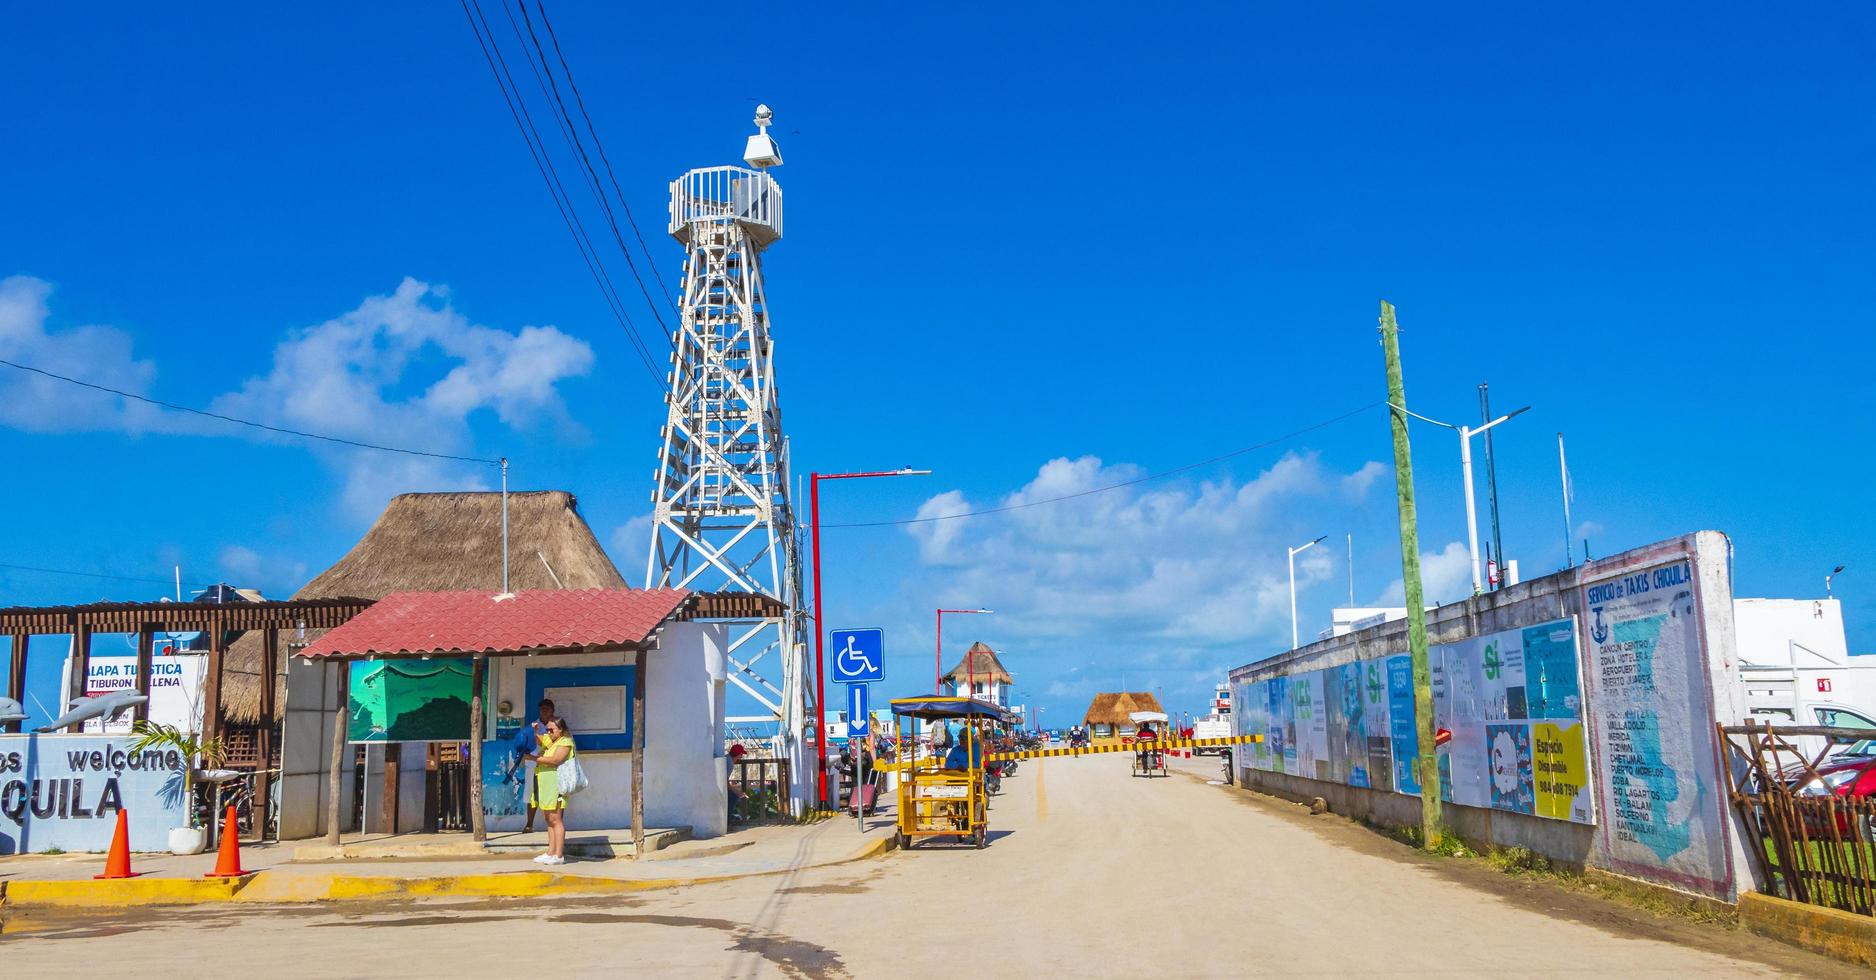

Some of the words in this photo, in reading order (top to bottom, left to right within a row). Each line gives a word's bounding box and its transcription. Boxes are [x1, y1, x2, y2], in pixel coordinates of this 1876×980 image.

[1588, 583, 1615, 604] SERVICIO
[1616, 584, 1624, 598] de
[1624, 573, 1650, 596] TAXIS
[1653, 563, 1692, 590] CHIQUILA
[1624, 640, 1649, 652] CENTRO
[1484, 640, 1501, 680] Sí
[1600, 655, 1616, 666] ZONA
[124, 663, 183, 677] TUSTICA
[1603, 664, 1642, 676] AEROPUERTO
[90, 678, 133, 689] TIBURON
[1602, 676, 1625, 687] PUERTO
[1606, 720, 1646, 730] VALLADOLID
[1608, 732, 1631, 741] MERIDA
[67, 743, 180, 772] welcome
[1609, 753, 1647, 766] CHETUMAL
[1610, 764, 1634, 776] PUERTO
[1635, 764, 1664, 777] MORELOS
[1612, 775, 1630, 786] COBA
[1612, 786, 1623, 797] RIO
[1625, 788, 1661, 801] LAGARTOS
[1614, 798, 1653, 811] EK-BALAM
[1615, 808, 1650, 822] SOLFERINO
[1617, 831, 1639, 844] IDEAL
